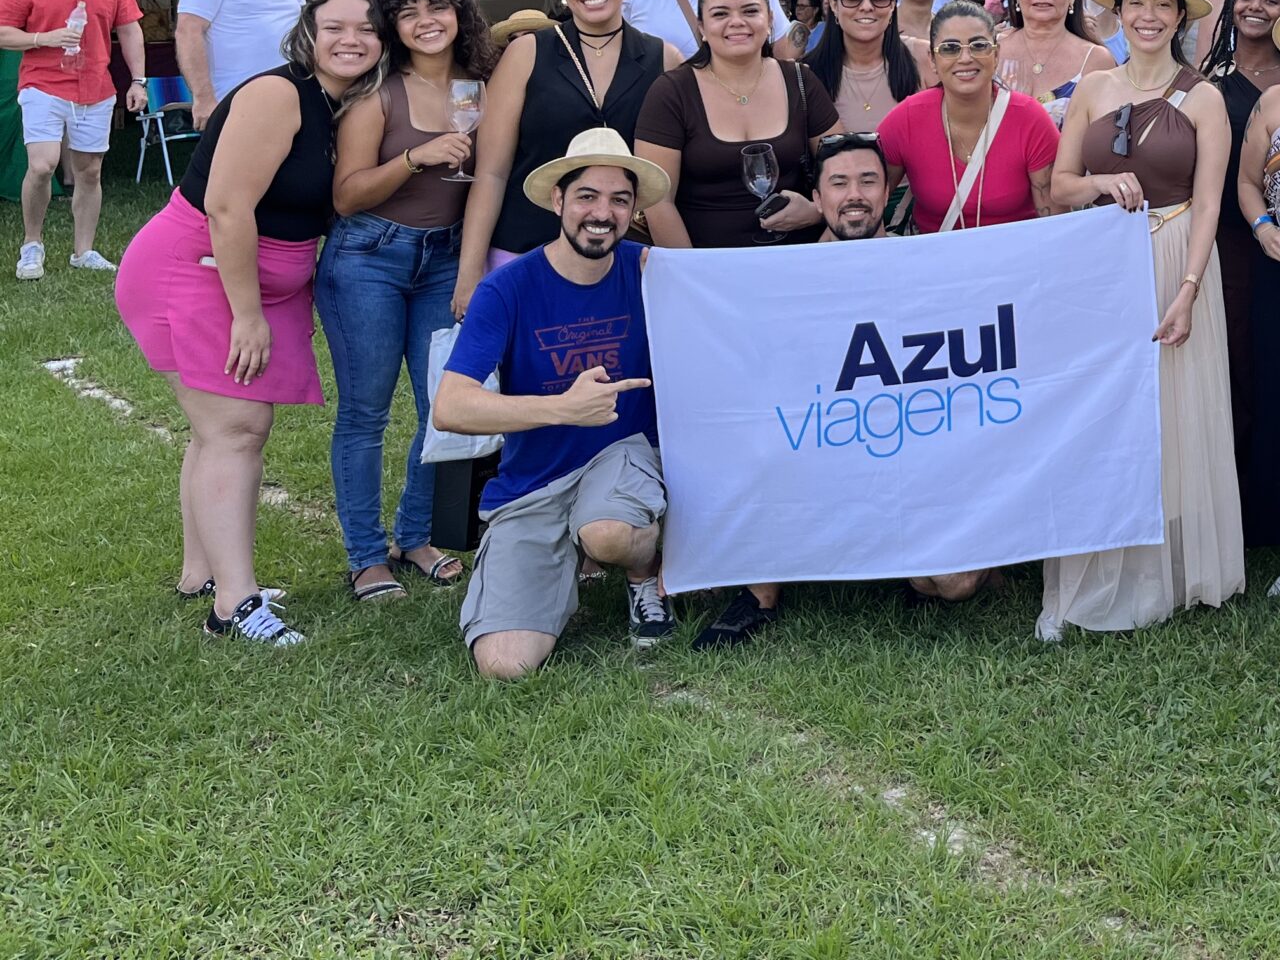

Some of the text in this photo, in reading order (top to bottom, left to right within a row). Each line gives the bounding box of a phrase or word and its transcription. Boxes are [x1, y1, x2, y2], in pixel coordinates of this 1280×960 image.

[550, 342, 621, 376] VANS
[557, 322, 613, 345] Original
[834, 303, 1017, 392] Azul
[775, 376, 1022, 458] viagens
